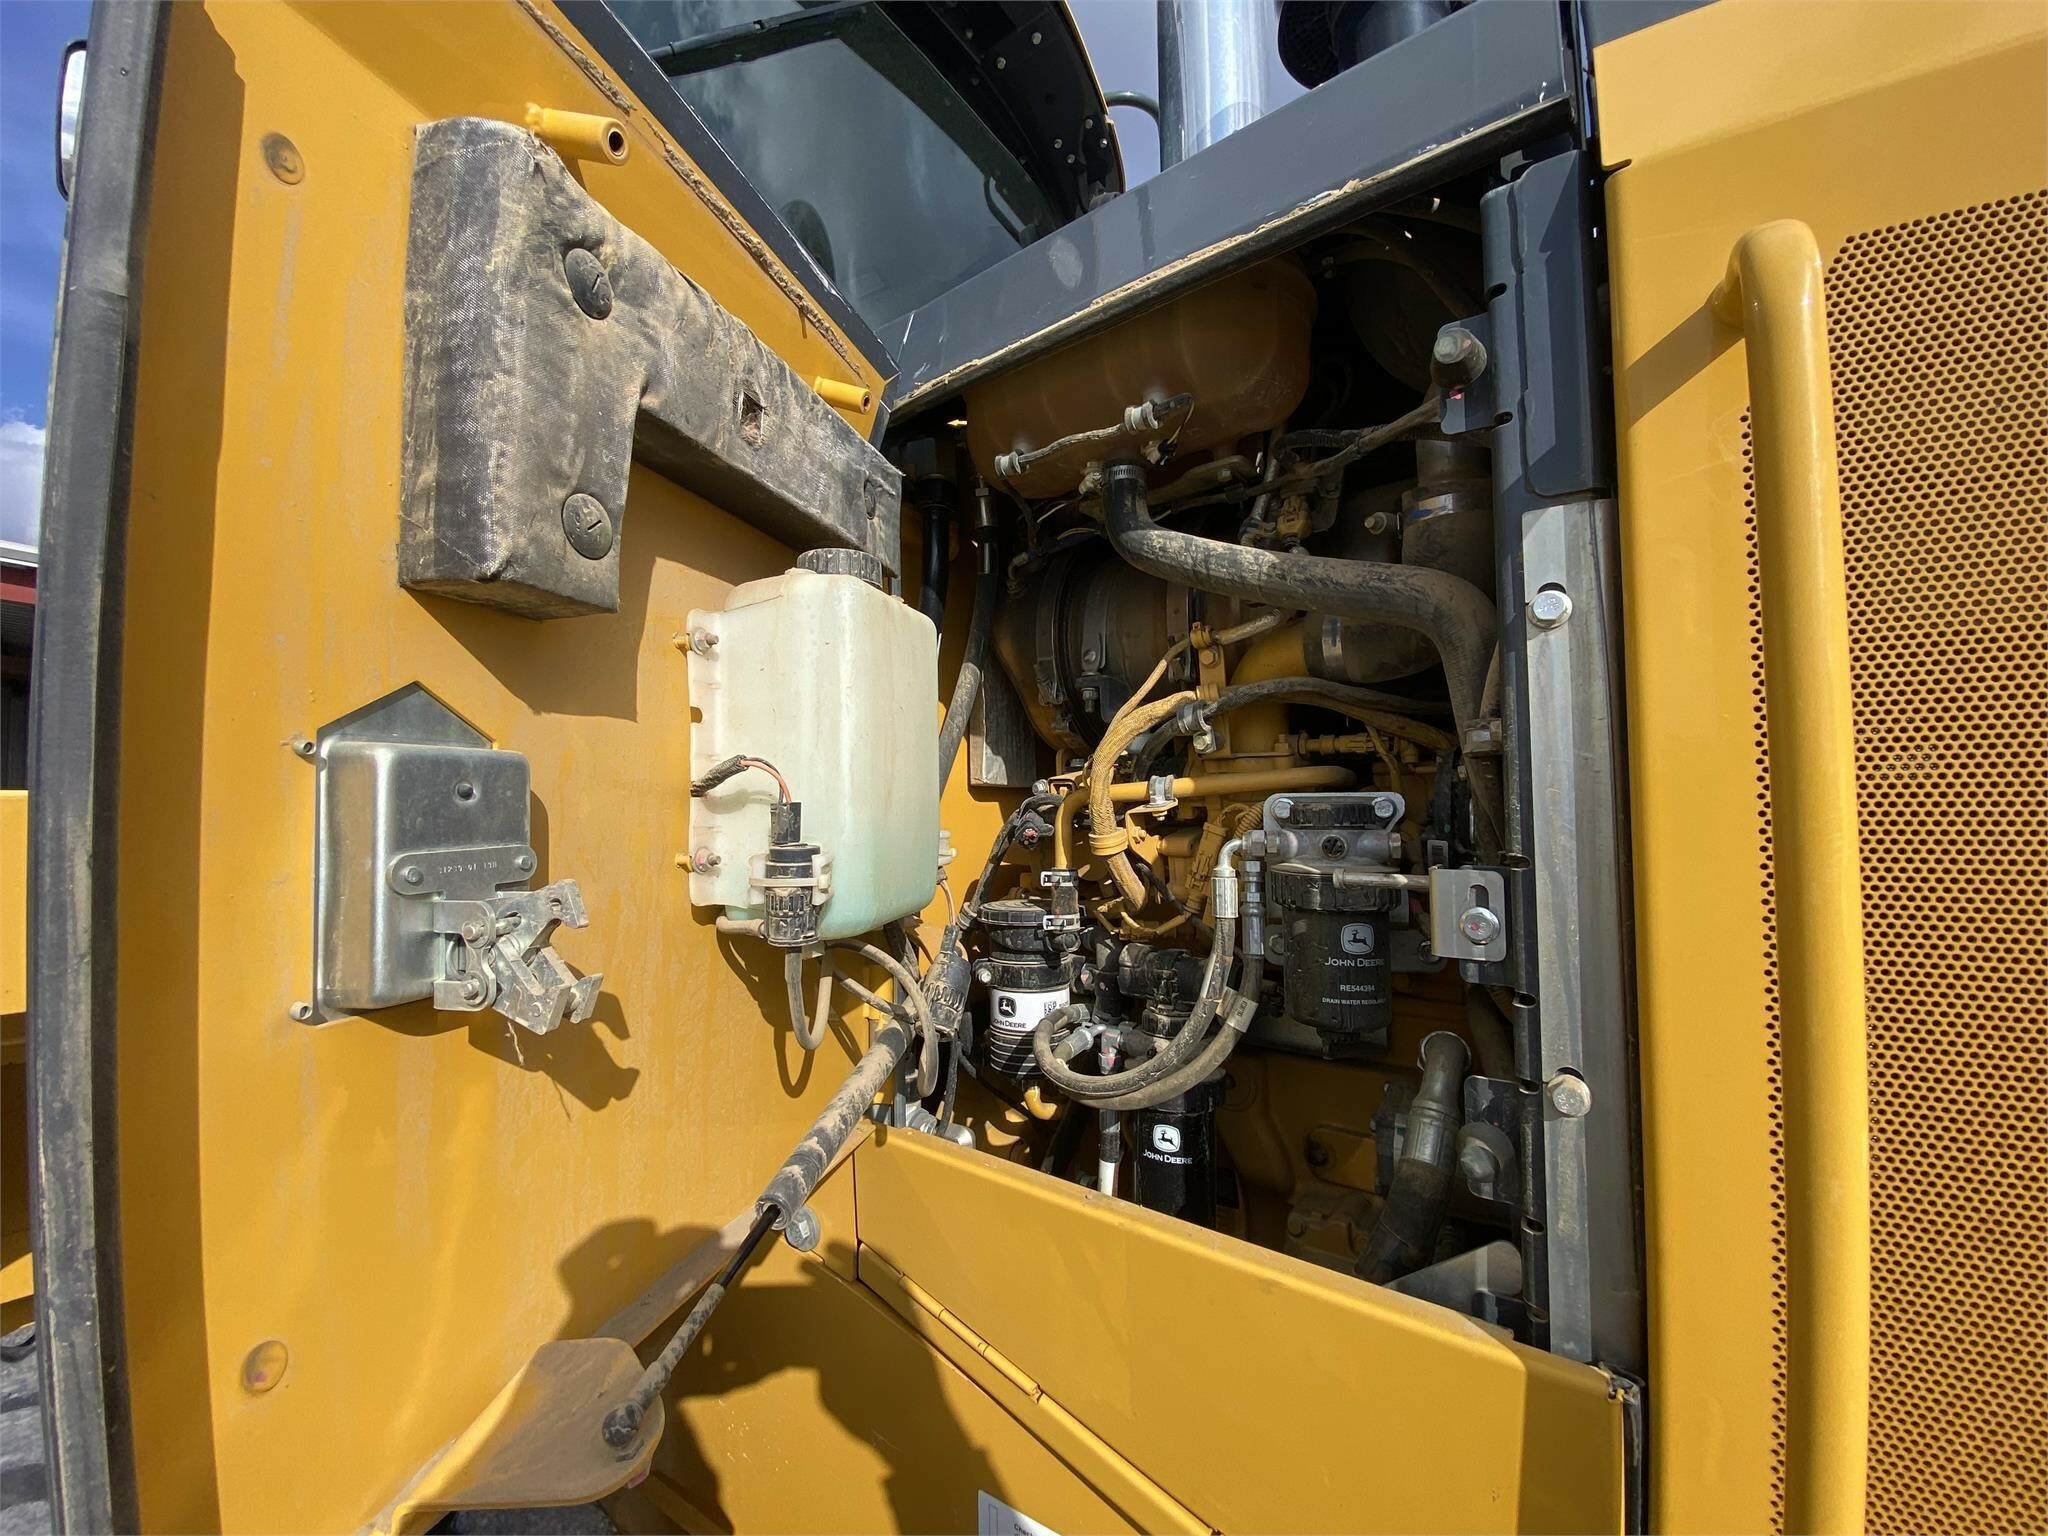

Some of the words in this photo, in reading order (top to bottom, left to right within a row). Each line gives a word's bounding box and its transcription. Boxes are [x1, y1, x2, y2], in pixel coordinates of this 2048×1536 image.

[1325, 956, 1355, 967] JOHN
[1357, 958, 1385, 967] DEERE
[1005, 1020, 1027, 1029] DEERE
[1143, 1149, 1163, 1162] JOHN
[1164, 1154, 1193, 1165] DEERE
